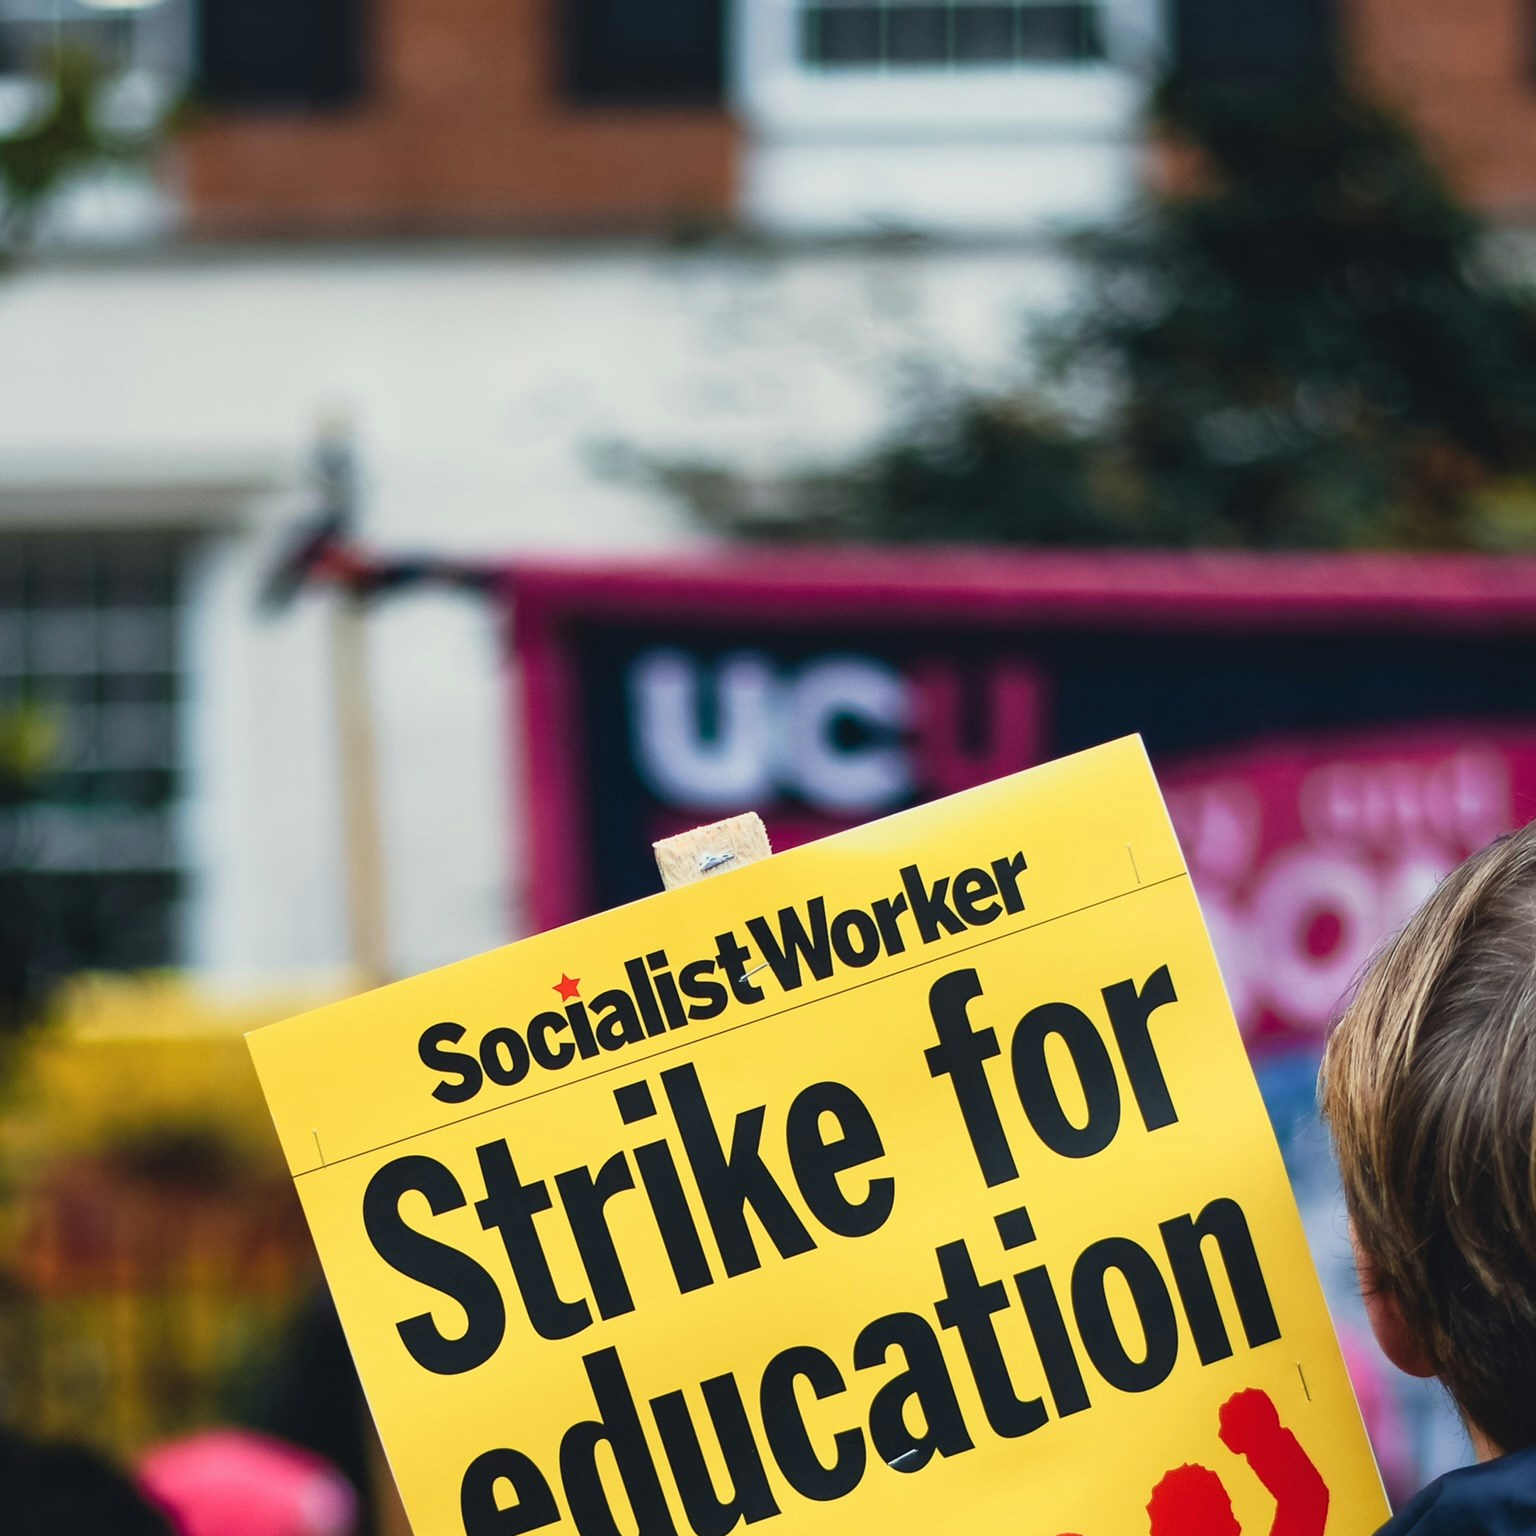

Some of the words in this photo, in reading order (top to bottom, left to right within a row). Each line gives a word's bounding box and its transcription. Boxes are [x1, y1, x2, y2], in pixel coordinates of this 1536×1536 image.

[629, 648, 1046, 810] UCU
[363, 1062, 894, 1375] Strike
[924, 965, 1178, 1188] for
